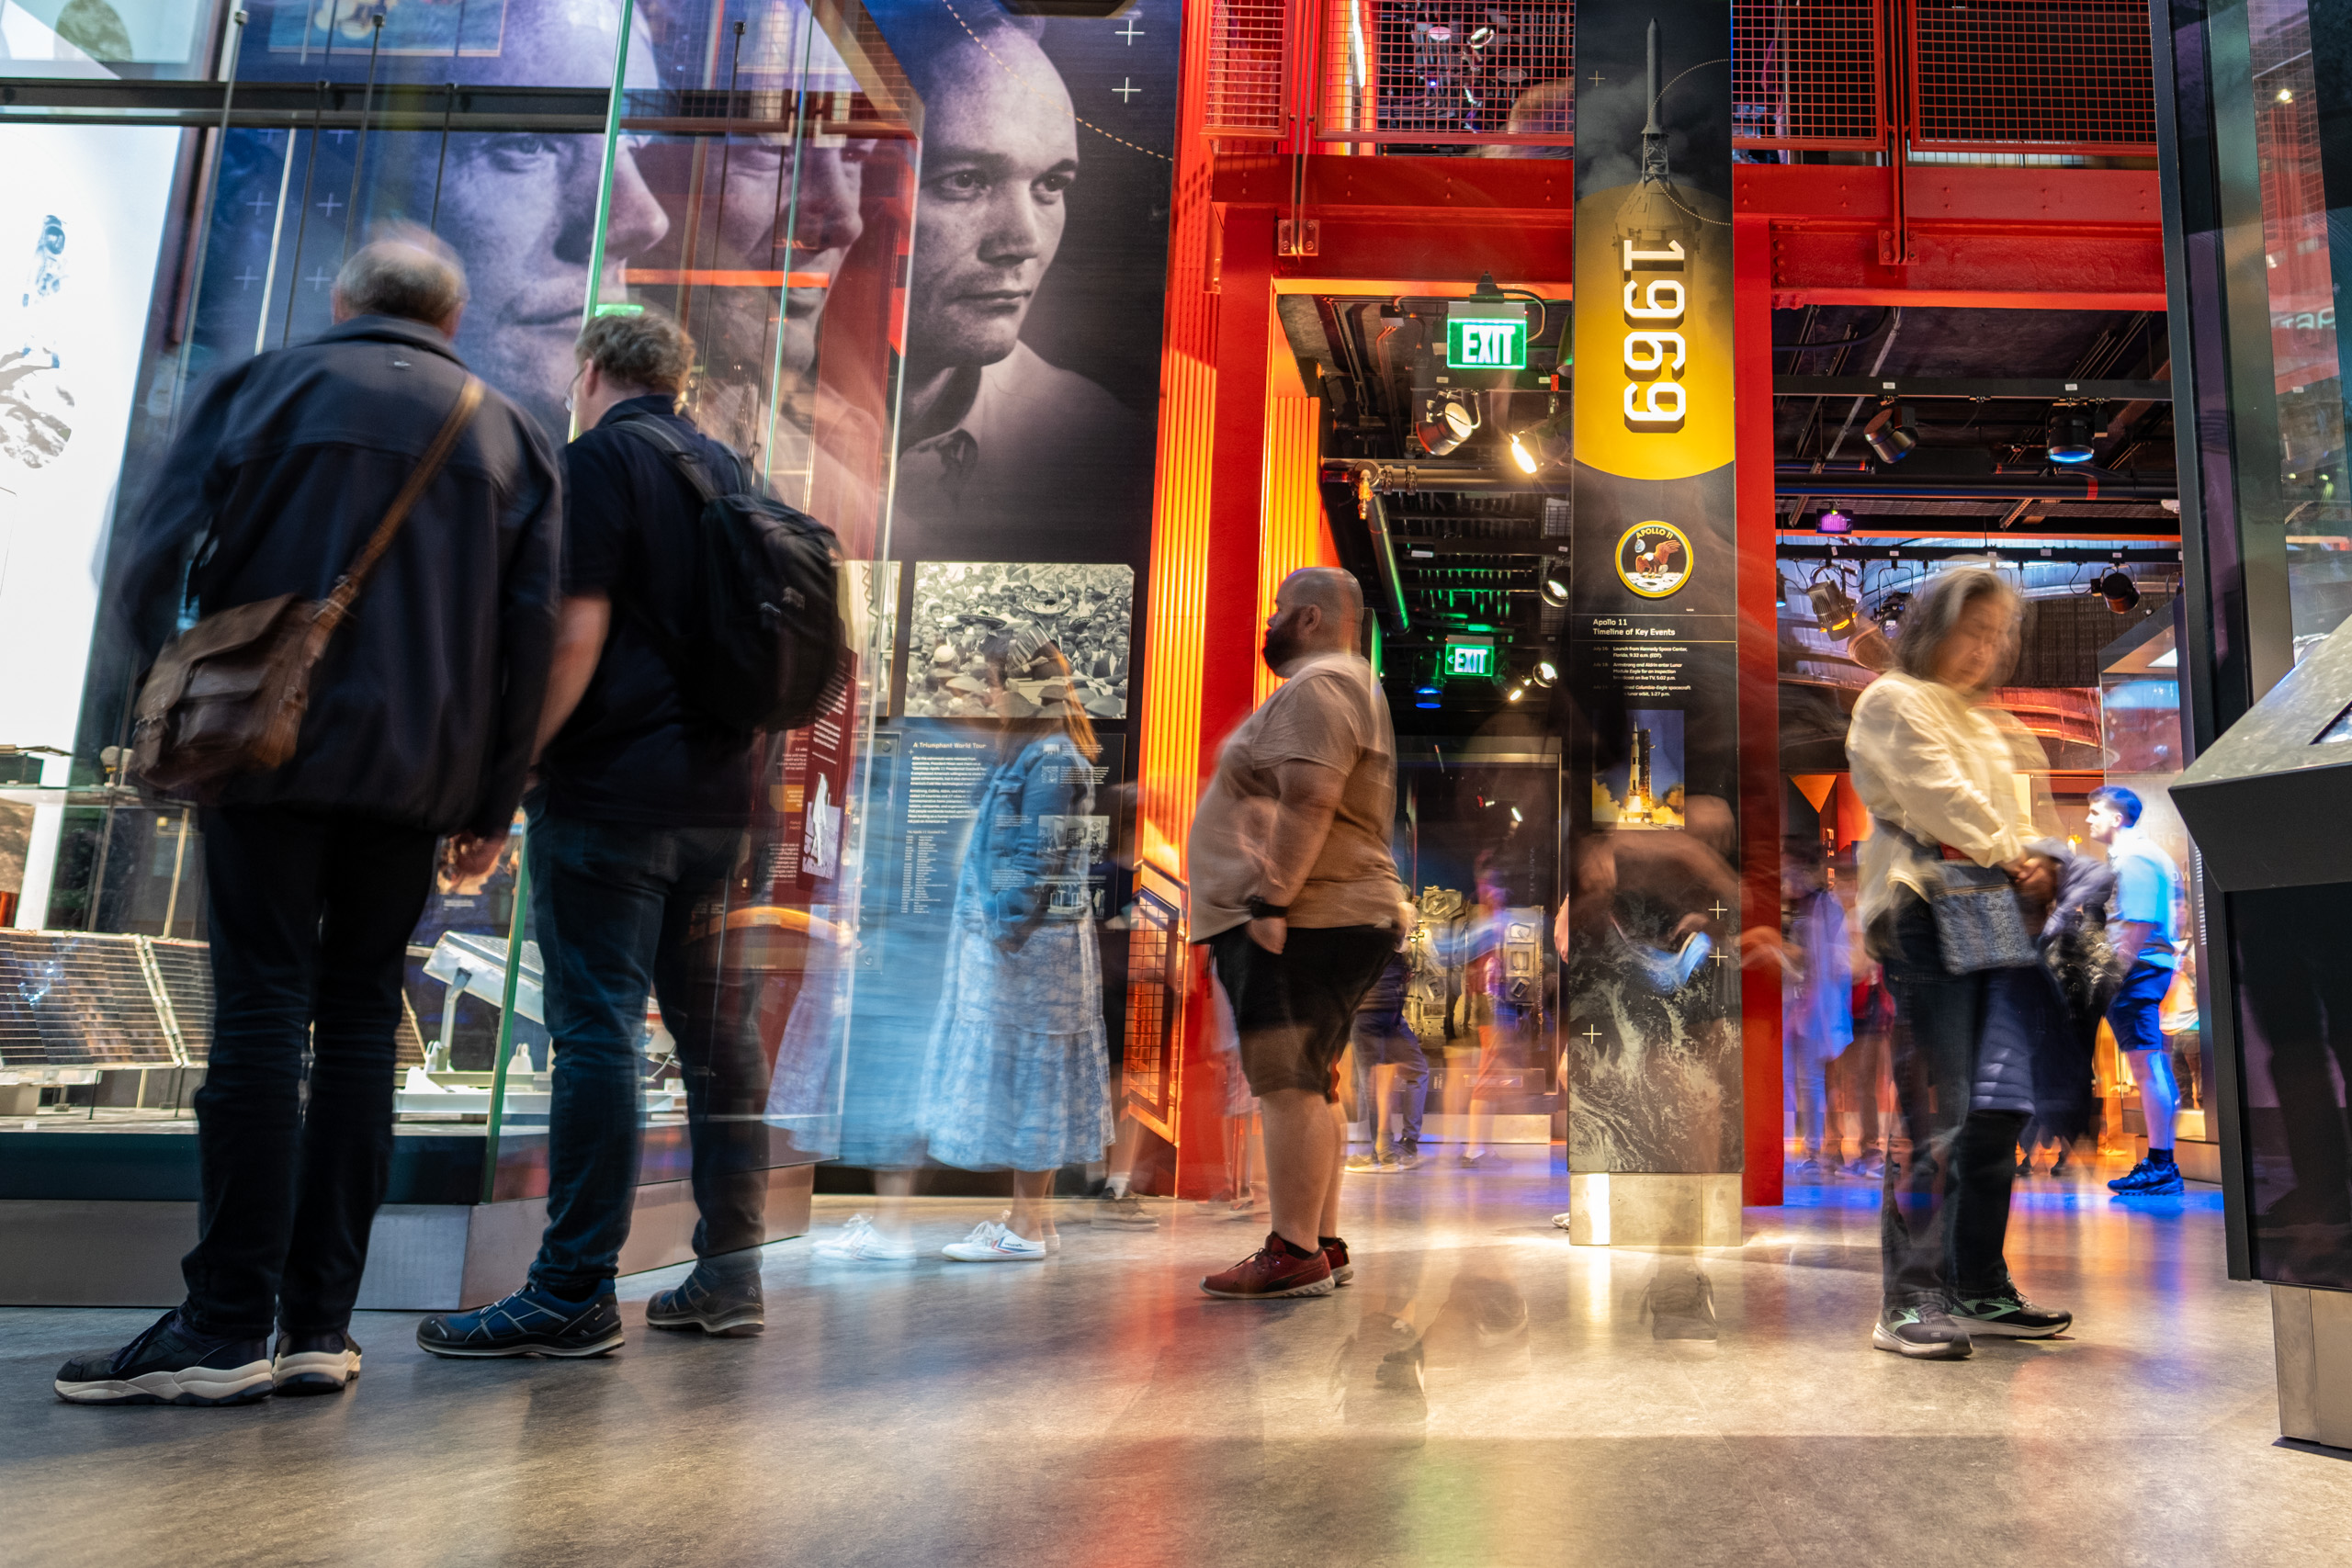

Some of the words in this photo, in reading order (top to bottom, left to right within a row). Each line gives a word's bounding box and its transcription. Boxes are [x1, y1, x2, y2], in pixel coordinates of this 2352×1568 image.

[1462, 325, 1515, 364] EXIT
[1623, 240, 1686, 422] 1969
[1636, 528, 1666, 539] APOLLO
[1666, 531, 1674, 540] 11
[1454, 648, 1488, 673] EXIT
